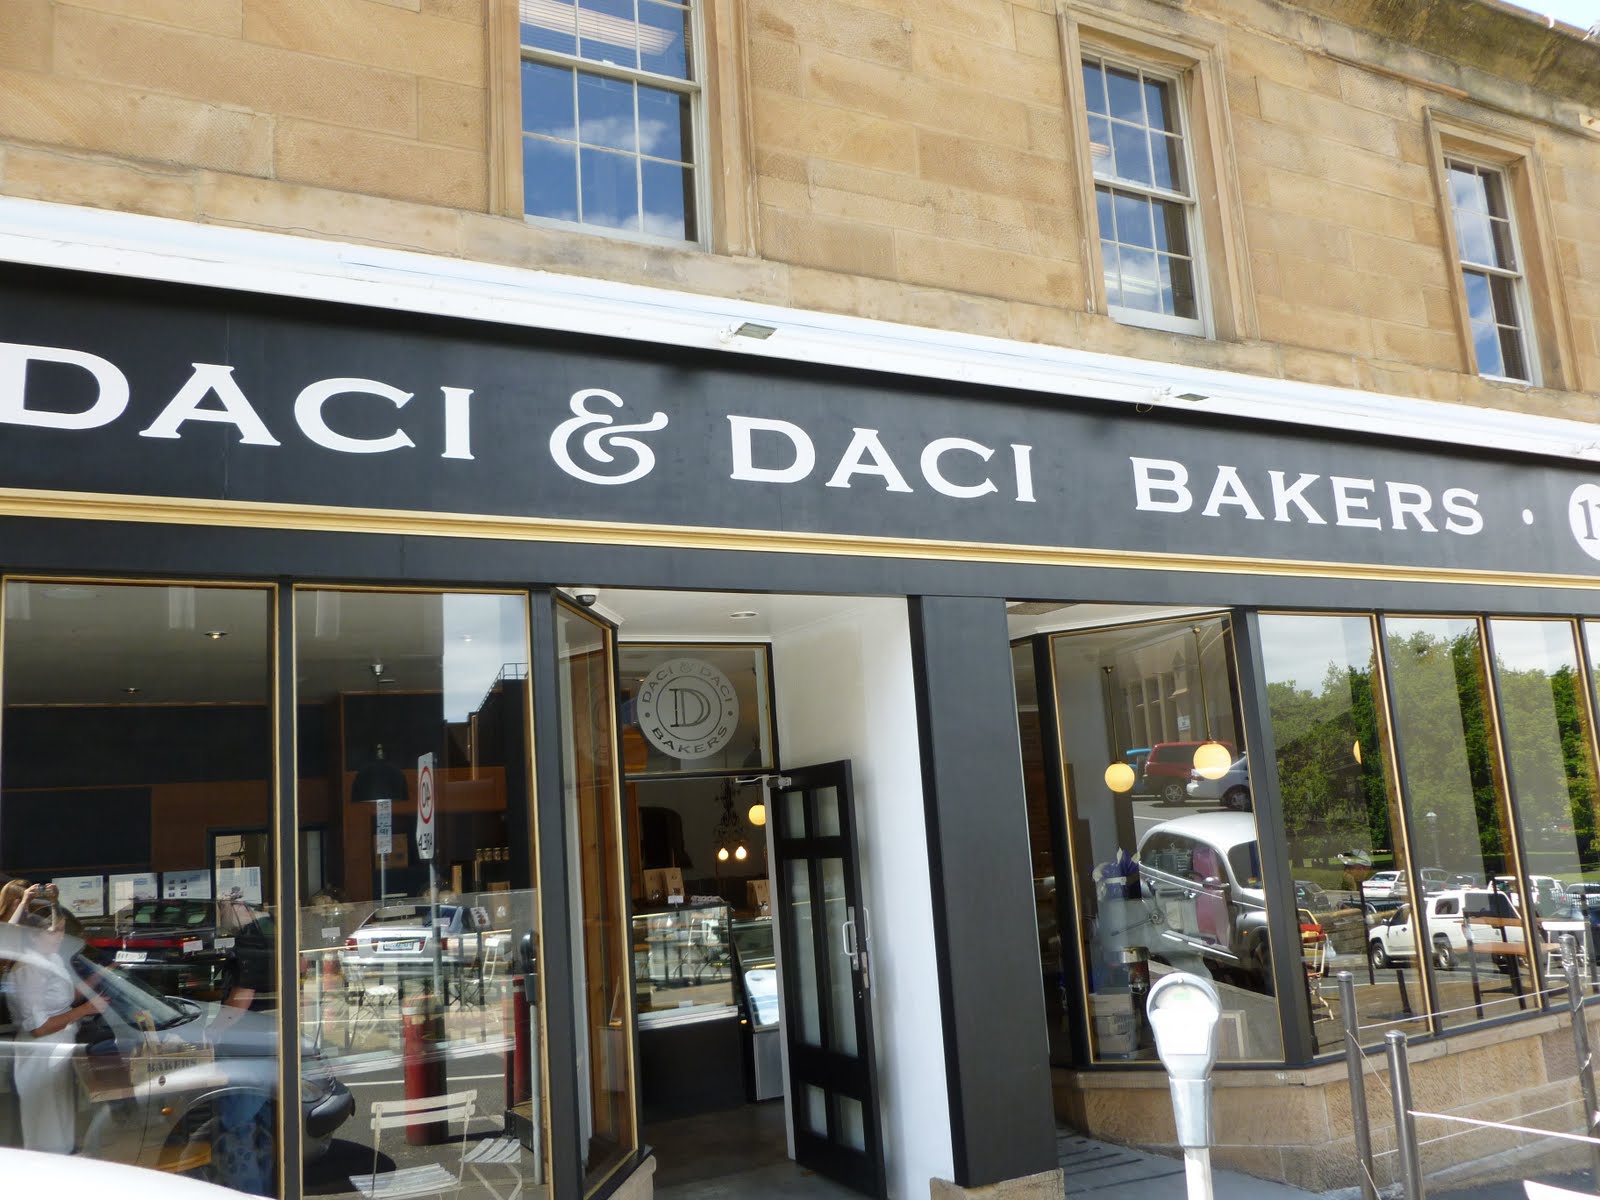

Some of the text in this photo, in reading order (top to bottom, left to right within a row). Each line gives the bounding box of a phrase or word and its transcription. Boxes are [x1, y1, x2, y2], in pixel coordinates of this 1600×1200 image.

[0, 342, 1484, 536] DACI & DACI BAKERS
[642, 665, 674, 703] DACI
[699, 665, 733, 702] DACI
[669, 687, 711, 727] D
[651, 726, 728, 754] BAKERS
